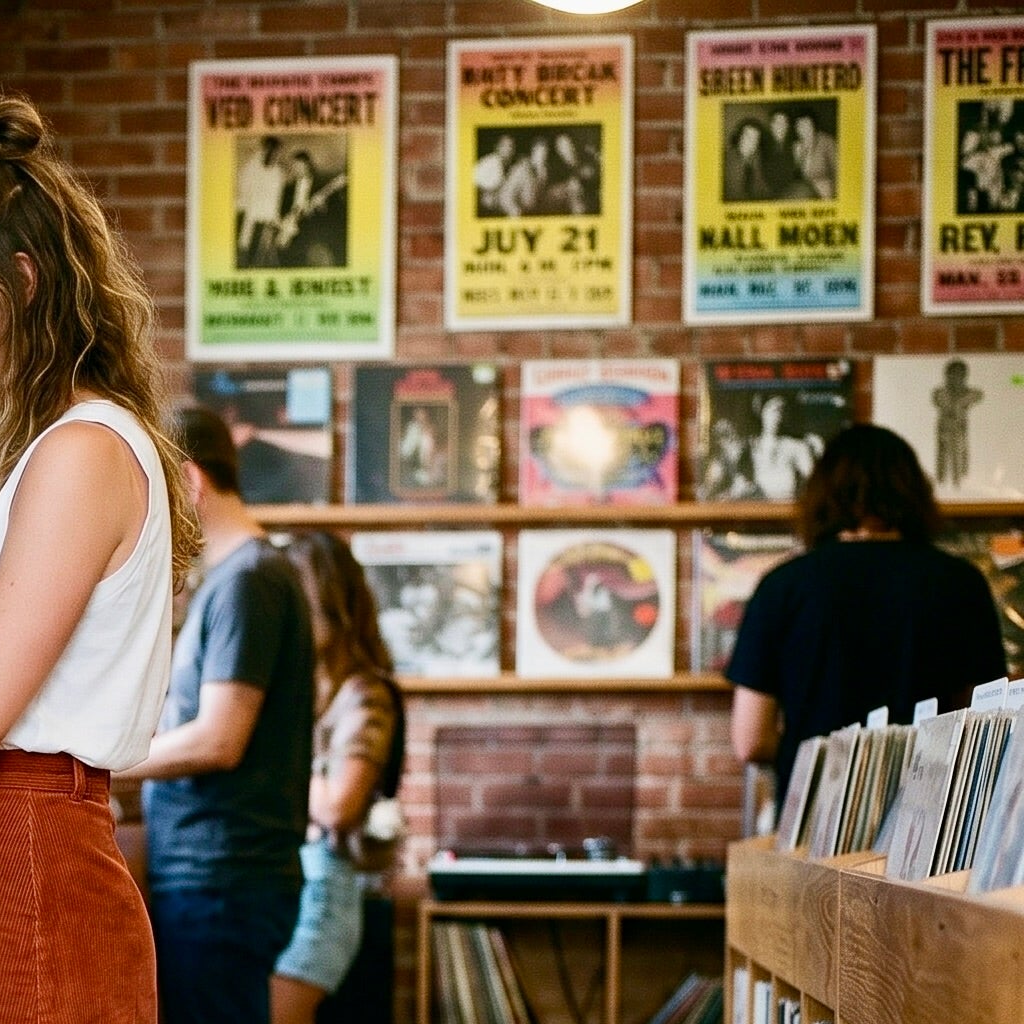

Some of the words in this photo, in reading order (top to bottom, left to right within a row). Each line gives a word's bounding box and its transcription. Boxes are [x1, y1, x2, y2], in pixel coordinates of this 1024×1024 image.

[939, 46, 991, 86] THE
[263, 91, 377, 127] CONCERT
[480, 85, 594, 107] CONCERT
[474, 229, 543, 255] JUY
[561, 226, 597, 252] 21
